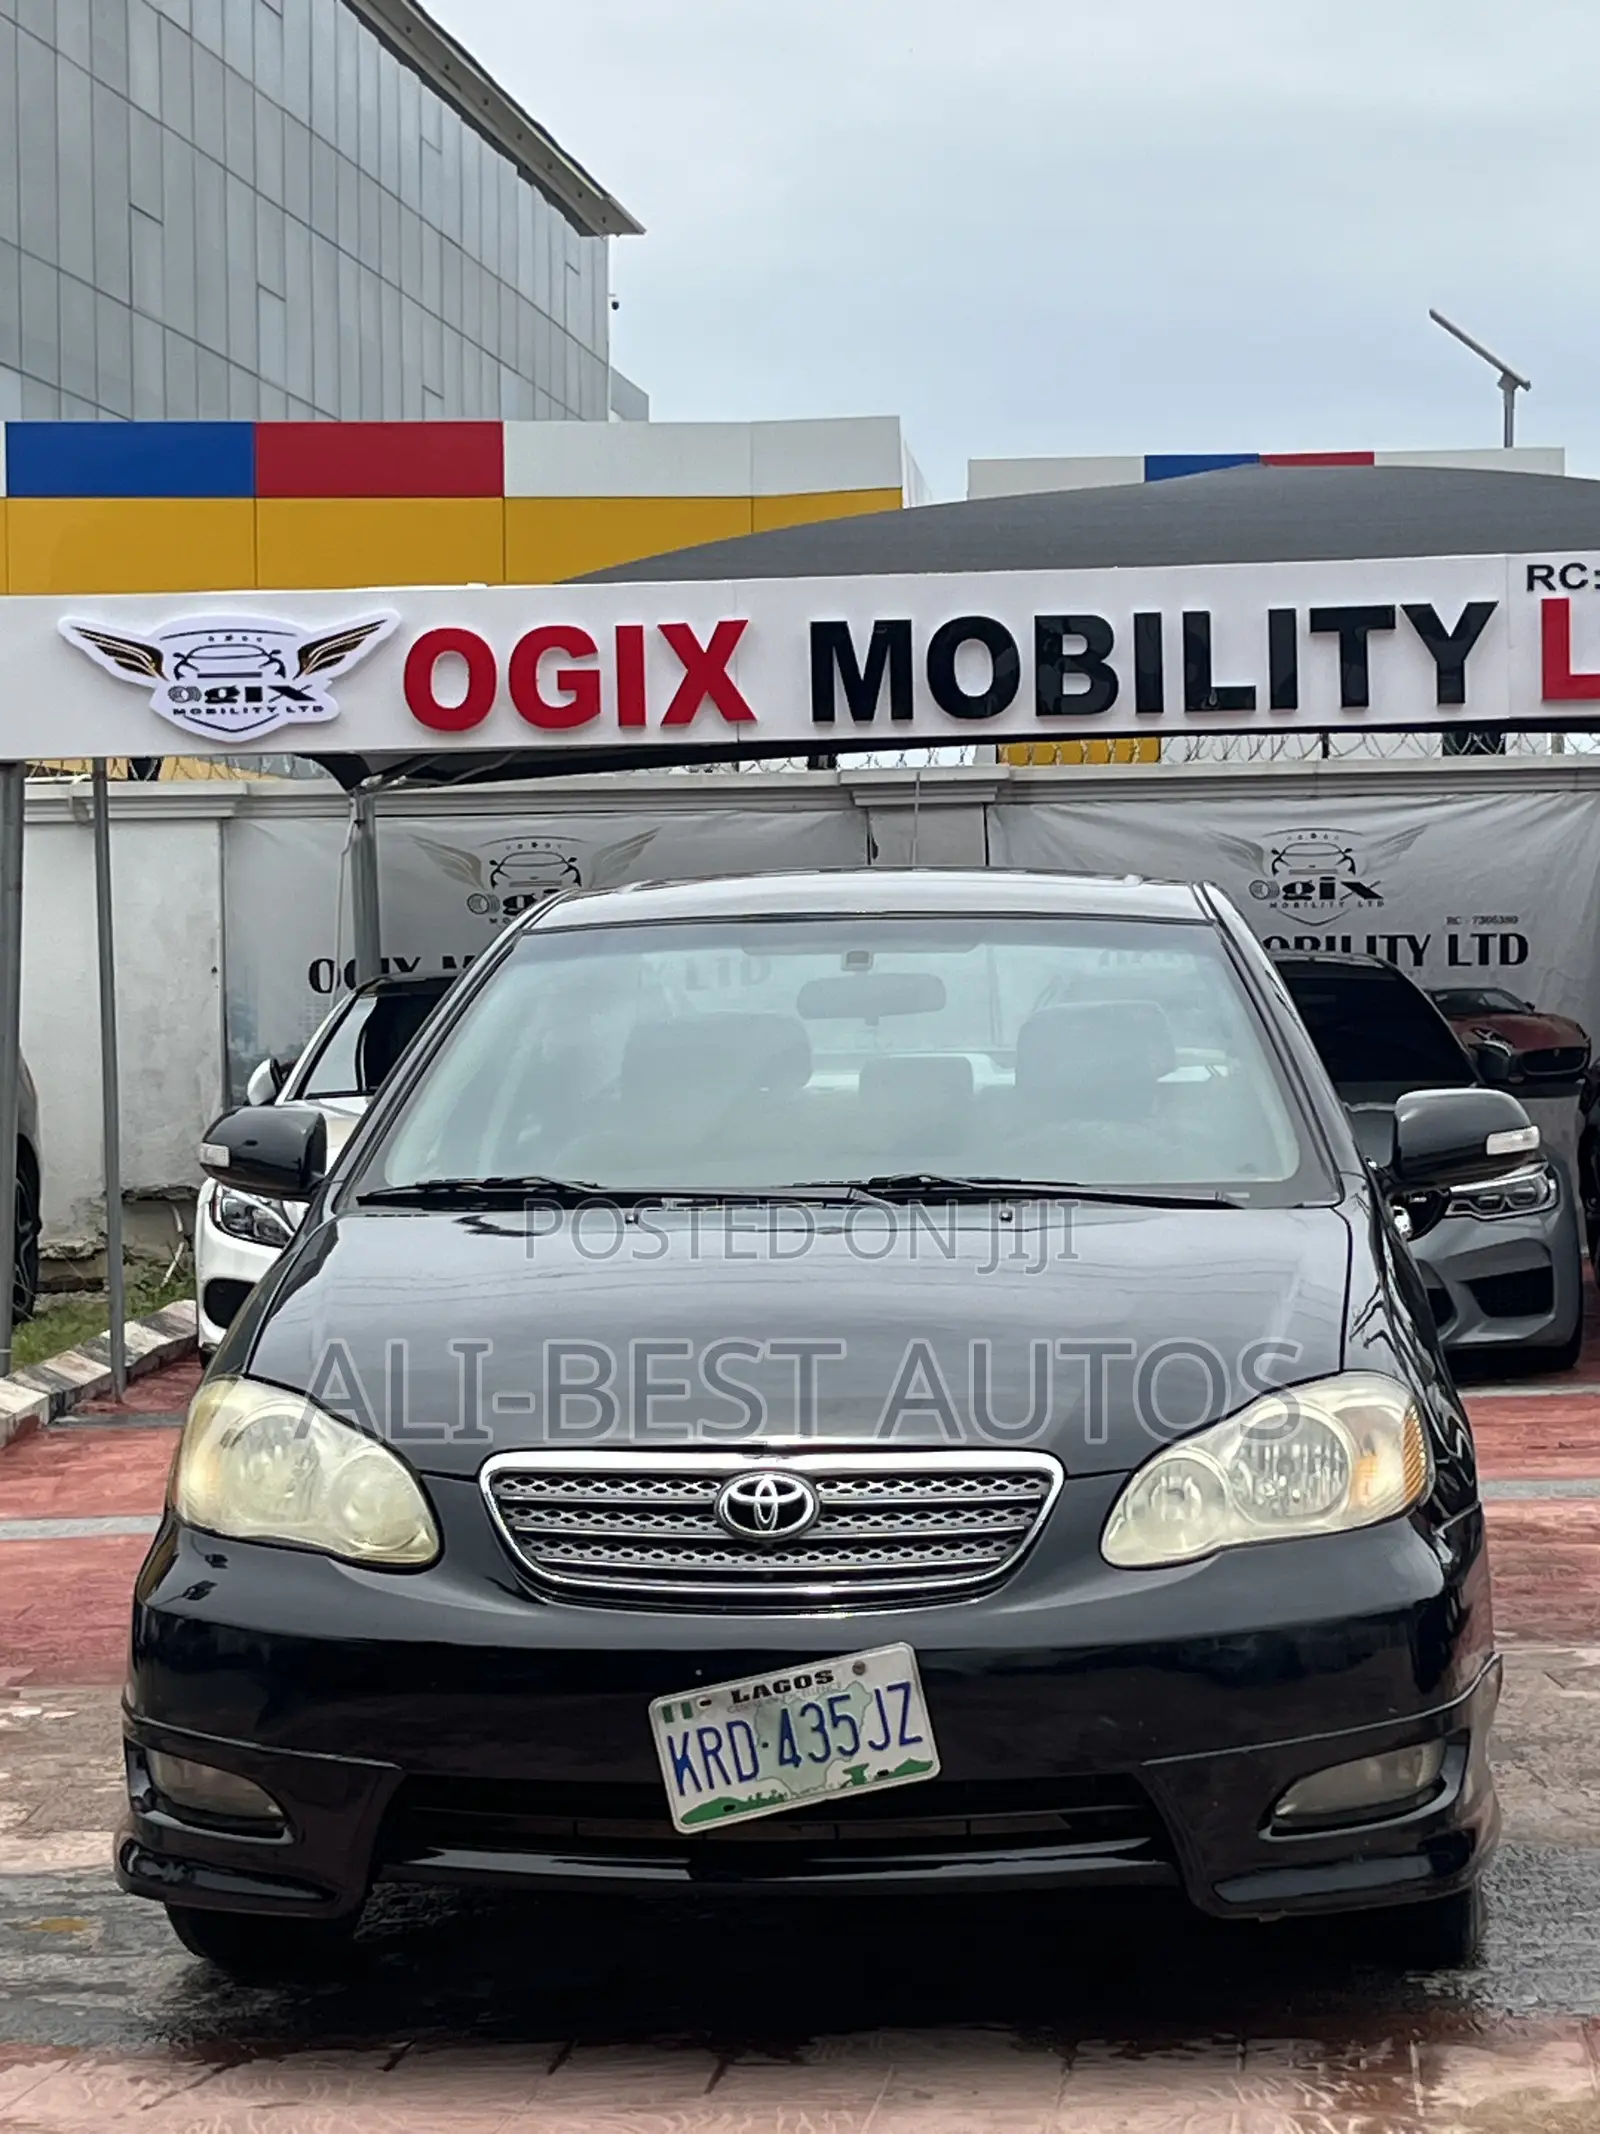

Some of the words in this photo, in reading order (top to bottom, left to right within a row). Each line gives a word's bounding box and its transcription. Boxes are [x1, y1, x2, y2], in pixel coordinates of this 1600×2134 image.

[403, 619, 757, 732] OGIX
[809, 600, 1499, 723] MOBILITY
[173, 706, 277, 715] MOBILITY
[286, 705, 324, 713] LTD
[1269, 901, 1345, 909] MOBILITY
[1447, 933, 1529, 966] LTD
[730, 1669, 835, 1705] LAGOS
